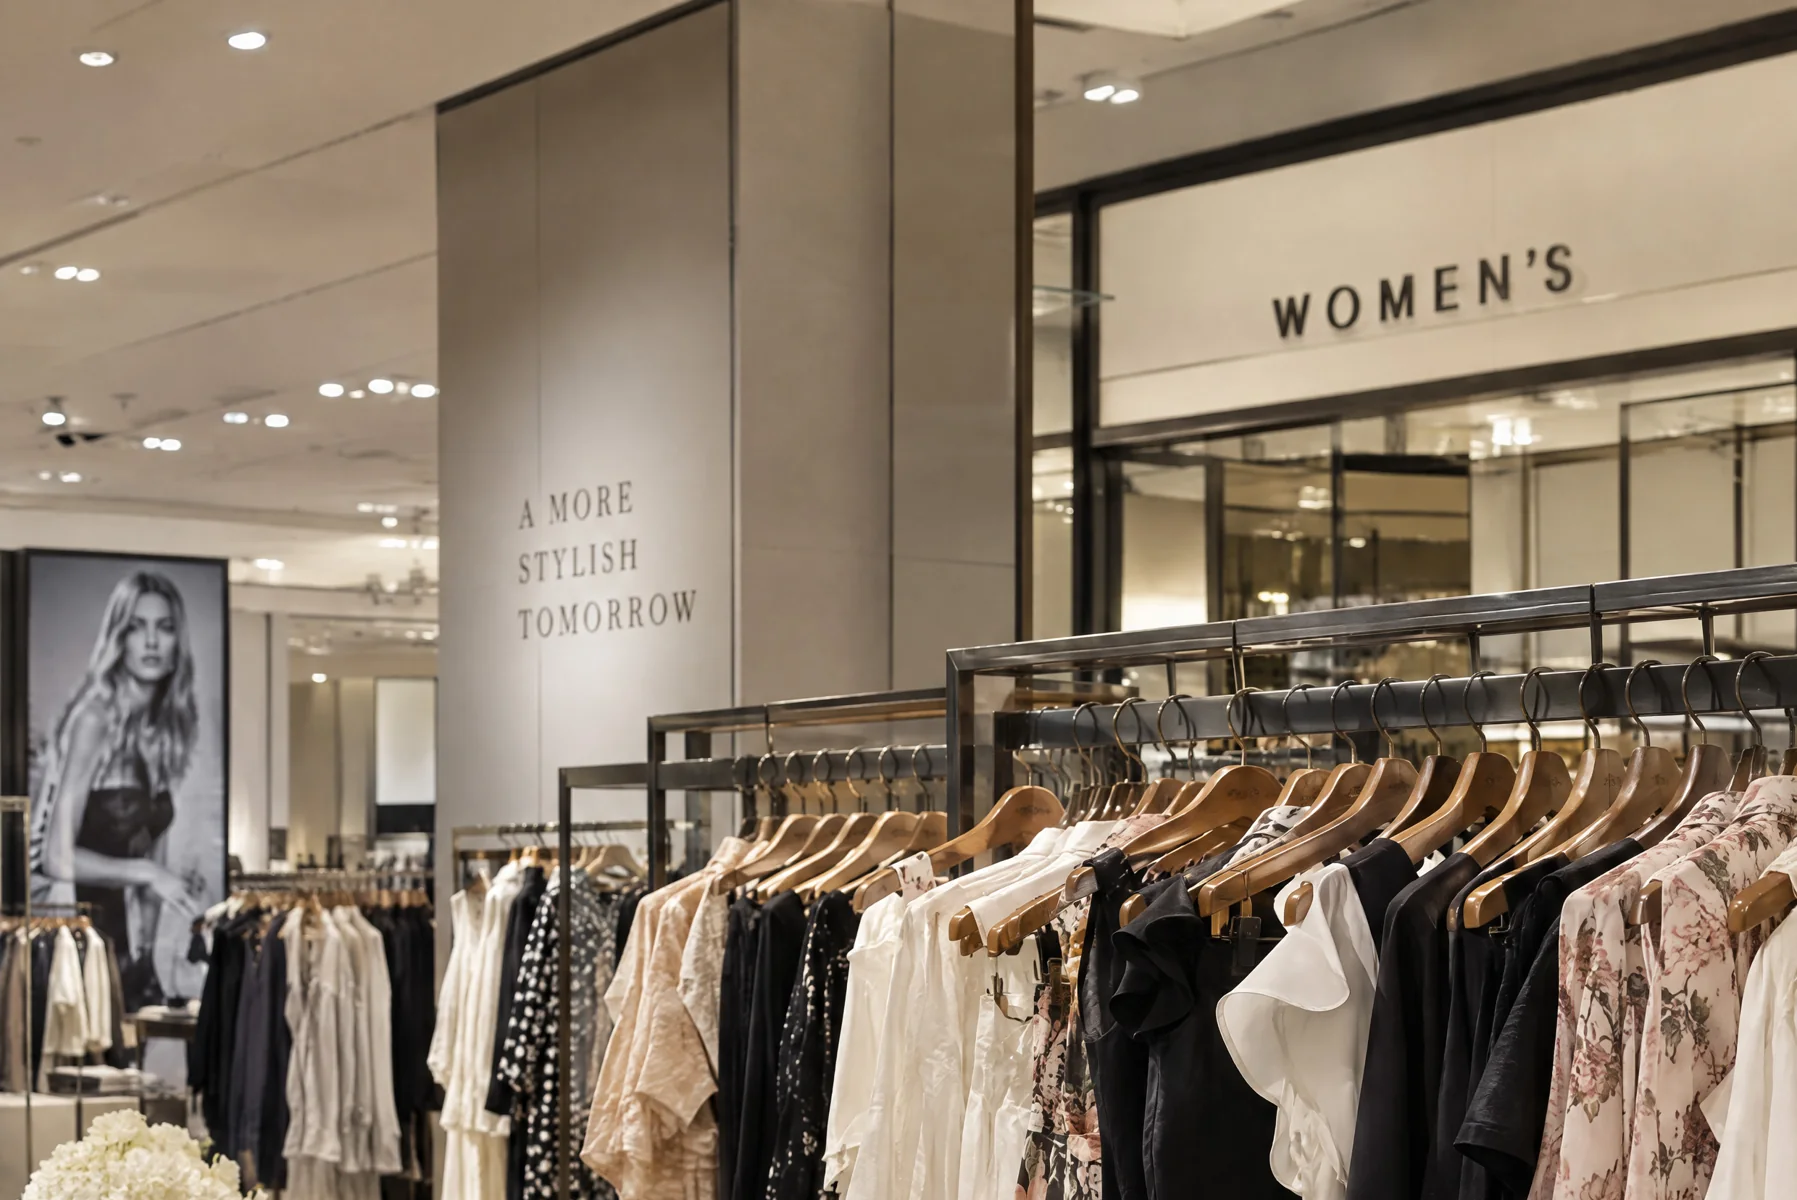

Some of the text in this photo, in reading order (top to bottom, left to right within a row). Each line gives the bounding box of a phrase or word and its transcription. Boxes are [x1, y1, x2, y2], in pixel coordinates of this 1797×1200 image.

[1272, 243, 1572, 338] WOMEN'S
[518, 480, 633, 530] A MORE
[518, 538, 637, 585] STYLISH
[518, 589, 697, 640] TOMORROW
